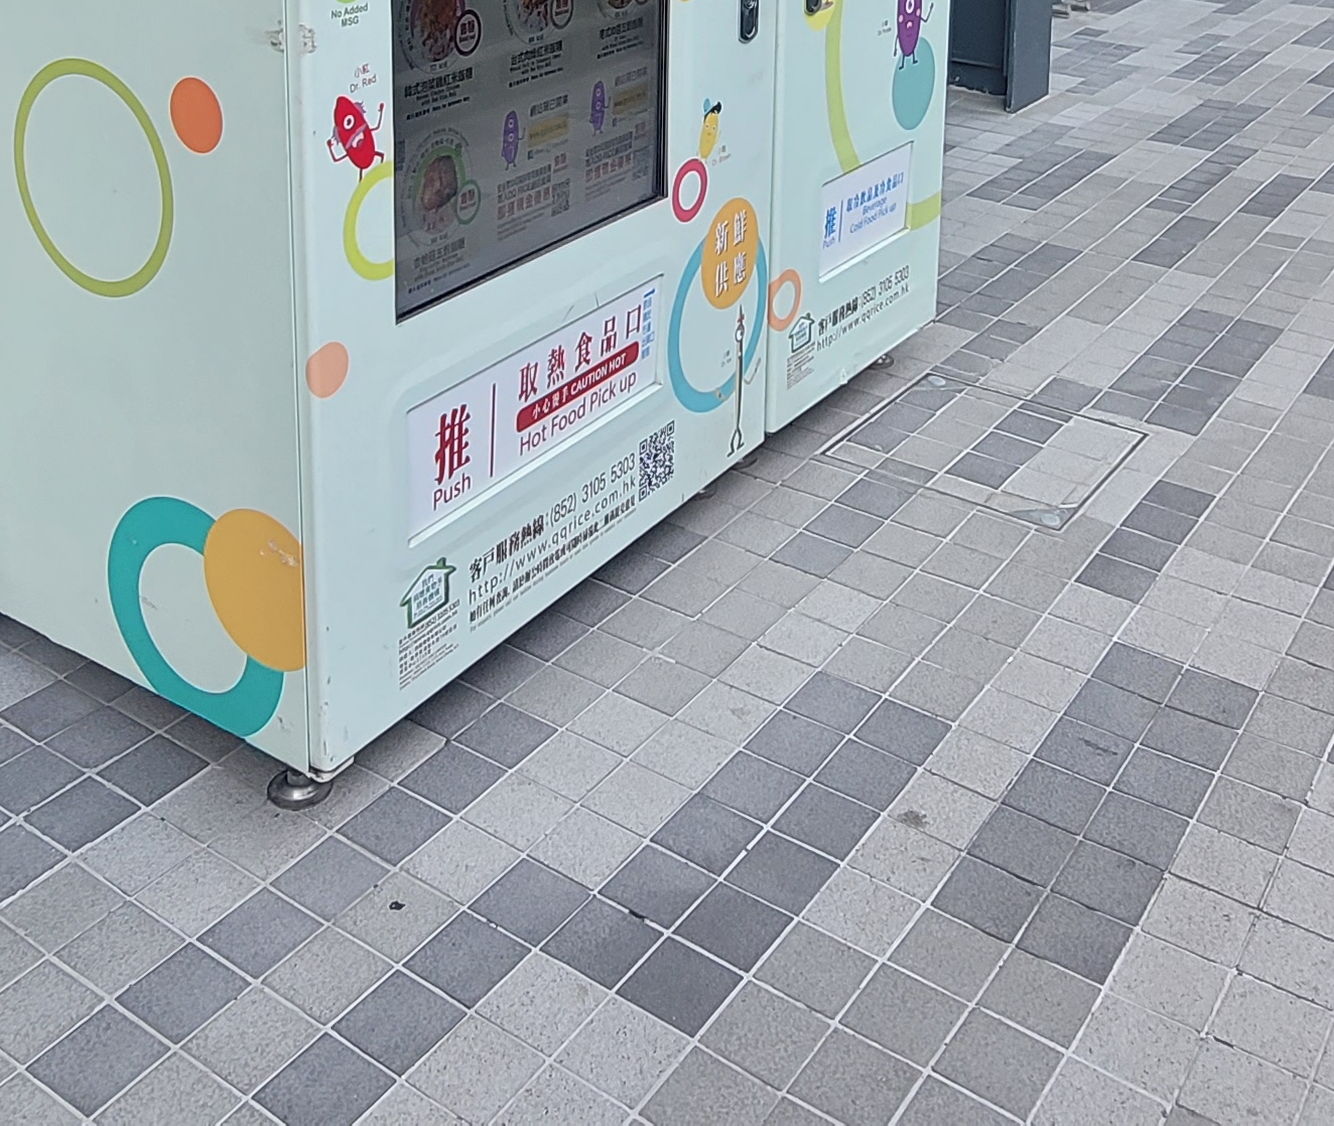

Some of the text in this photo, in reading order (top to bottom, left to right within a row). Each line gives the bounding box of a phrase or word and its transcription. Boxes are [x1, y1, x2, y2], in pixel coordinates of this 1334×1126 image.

[331, 2, 369, 20] No Added
[341, 16, 360, 28] MSG
[349, 73, 377, 94] Dr. Red
[714, 209, 748, 254] 新鮮
[824, 206, 837, 239] 推
[714, 252, 747, 298] 供應
[518, 304, 643, 403] 取熱食品口
[570, 364, 608, 396] CAUTION
[608, 352, 627, 372] HOT
[519, 371, 637, 457] Hot Food Pick up
[434, 404, 471, 486] 推
[433, 472, 472, 512] Push
[581, 471, 607, 504] 3105
[610, 452, 636, 484] 5303
[469, 474, 637, 606] http://www.qqrice.com.hk
